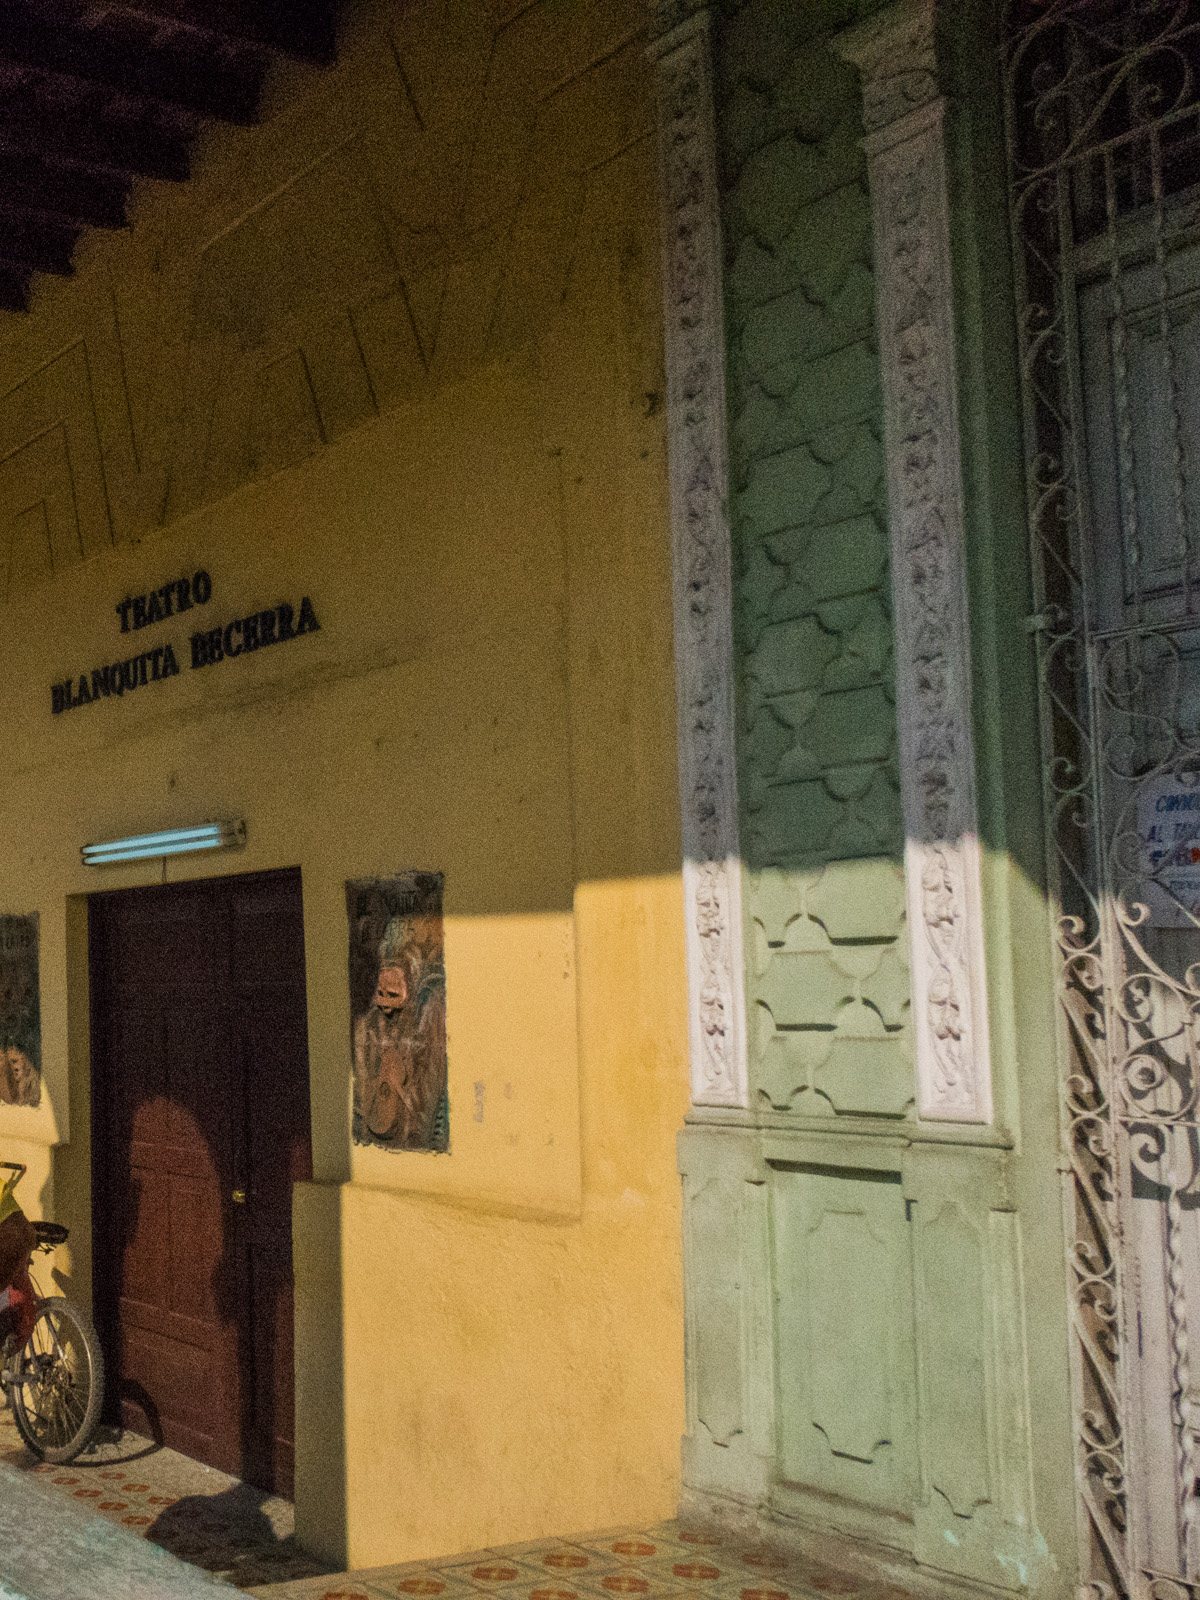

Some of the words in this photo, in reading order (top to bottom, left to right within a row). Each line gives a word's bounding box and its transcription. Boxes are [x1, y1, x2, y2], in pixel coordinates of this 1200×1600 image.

[116, 569, 212, 633] TEATRO
[51, 645, 180, 714] BLANQUITA
[190, 597, 321, 669] BECERRA
